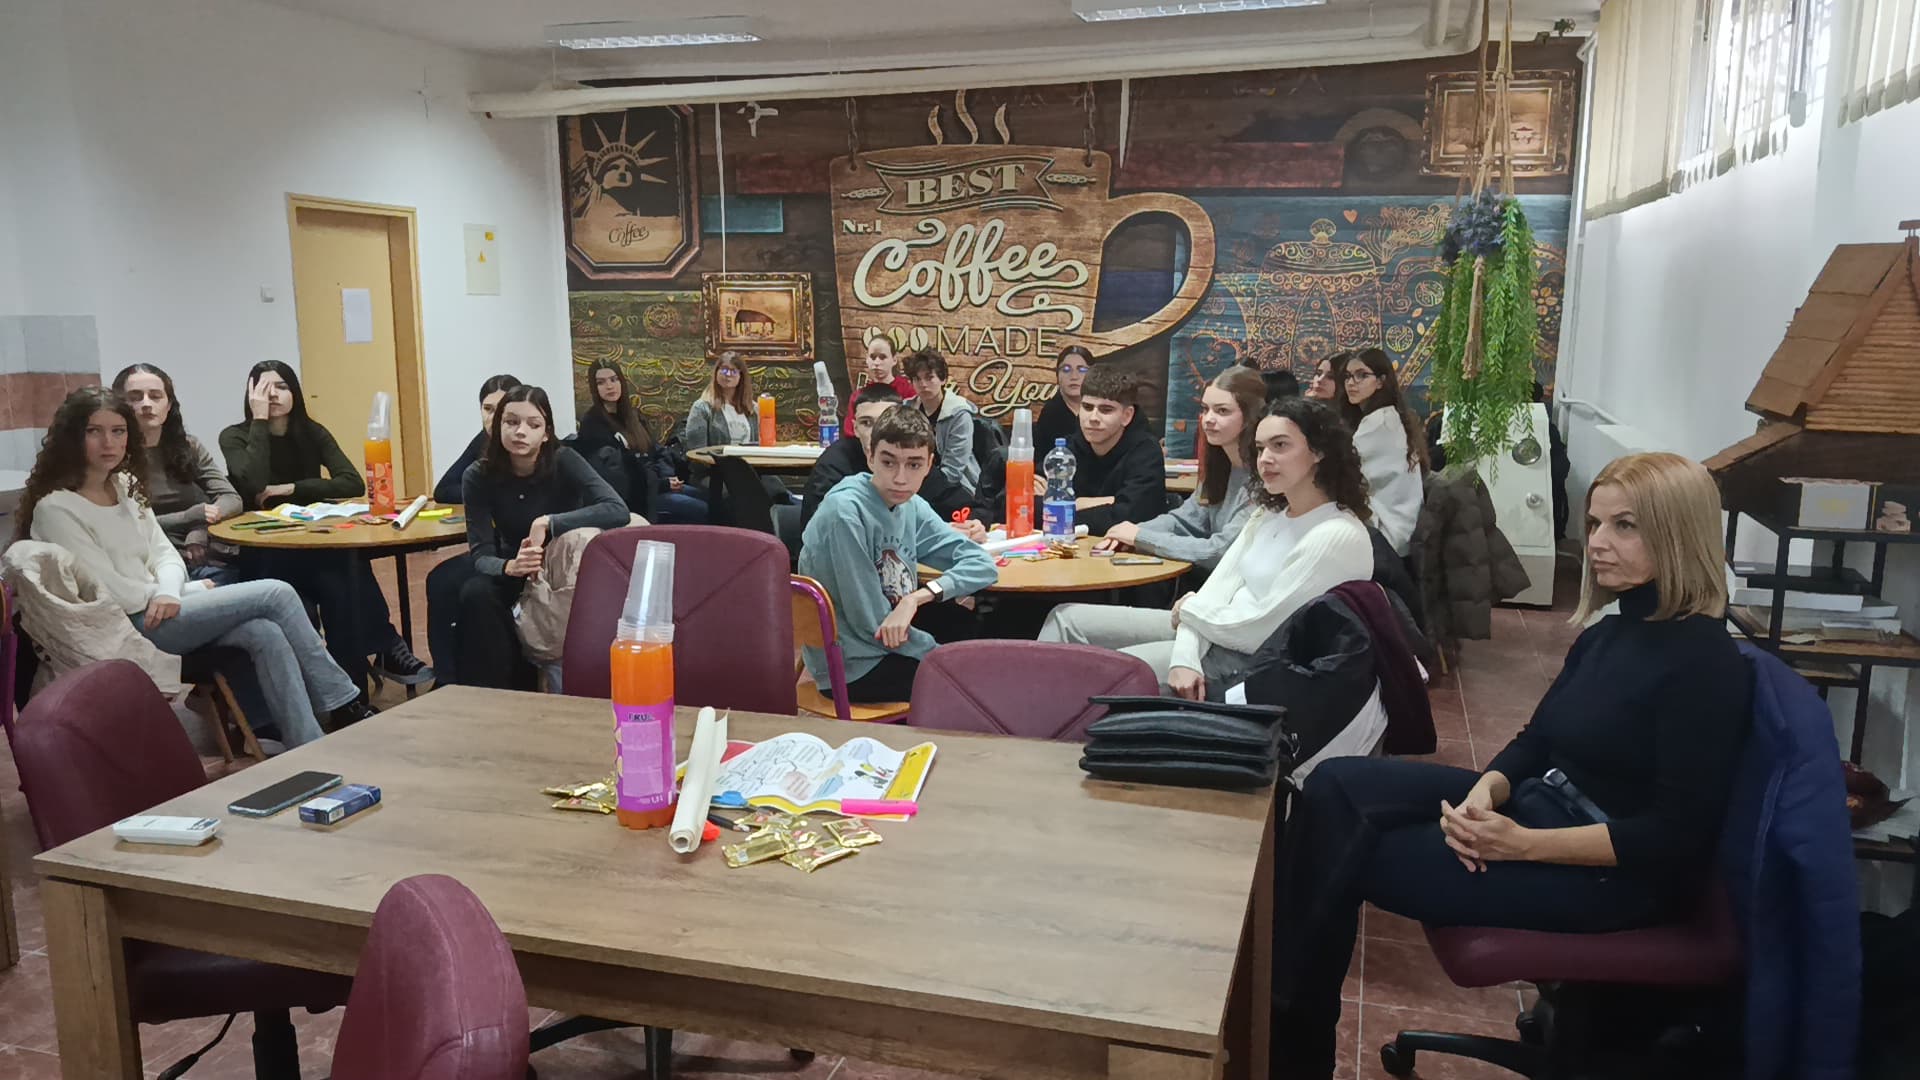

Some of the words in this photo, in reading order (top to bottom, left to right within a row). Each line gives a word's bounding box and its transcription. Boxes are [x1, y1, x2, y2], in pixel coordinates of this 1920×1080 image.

[906, 164, 1025, 206] BEST
[608, 221, 650, 248] Coffee
[854, 219, 1089, 329] Coffee
[937, 325, 1059, 357] MADE
